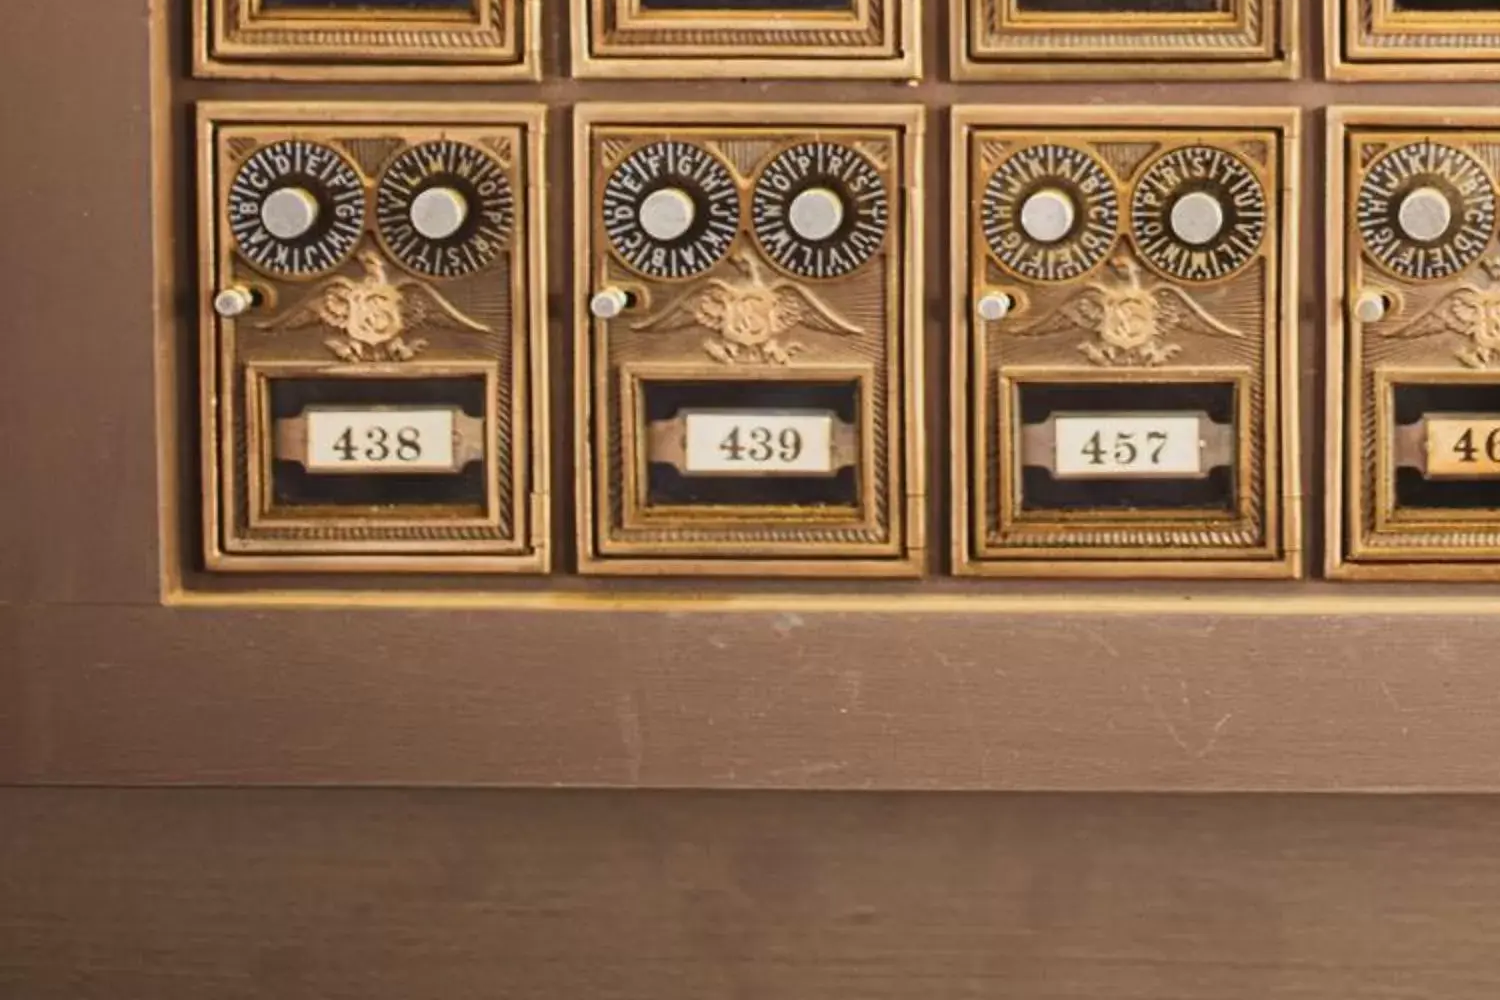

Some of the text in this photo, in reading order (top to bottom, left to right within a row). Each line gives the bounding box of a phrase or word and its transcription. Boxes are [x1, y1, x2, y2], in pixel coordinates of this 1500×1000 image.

[273, 155, 291, 175] D
[305, 155, 321, 177] E
[427, 154, 445, 173] M
[457, 157, 473, 178] N
[647, 157, 662, 177] F
[677, 156, 692, 177] G
[797, 157, 812, 176] P
[827, 156, 843, 176] R
[1027, 157, 1046, 178] K
[1056, 158, 1072, 179] A
[1191, 159, 1206, 176] S
[1406, 155, 1425, 175] K
[1435, 158, 1453, 179] A
[332, 426, 422, 462] 438
[719, 426, 803, 463] 439
[1080, 429, 1168, 466] 457
